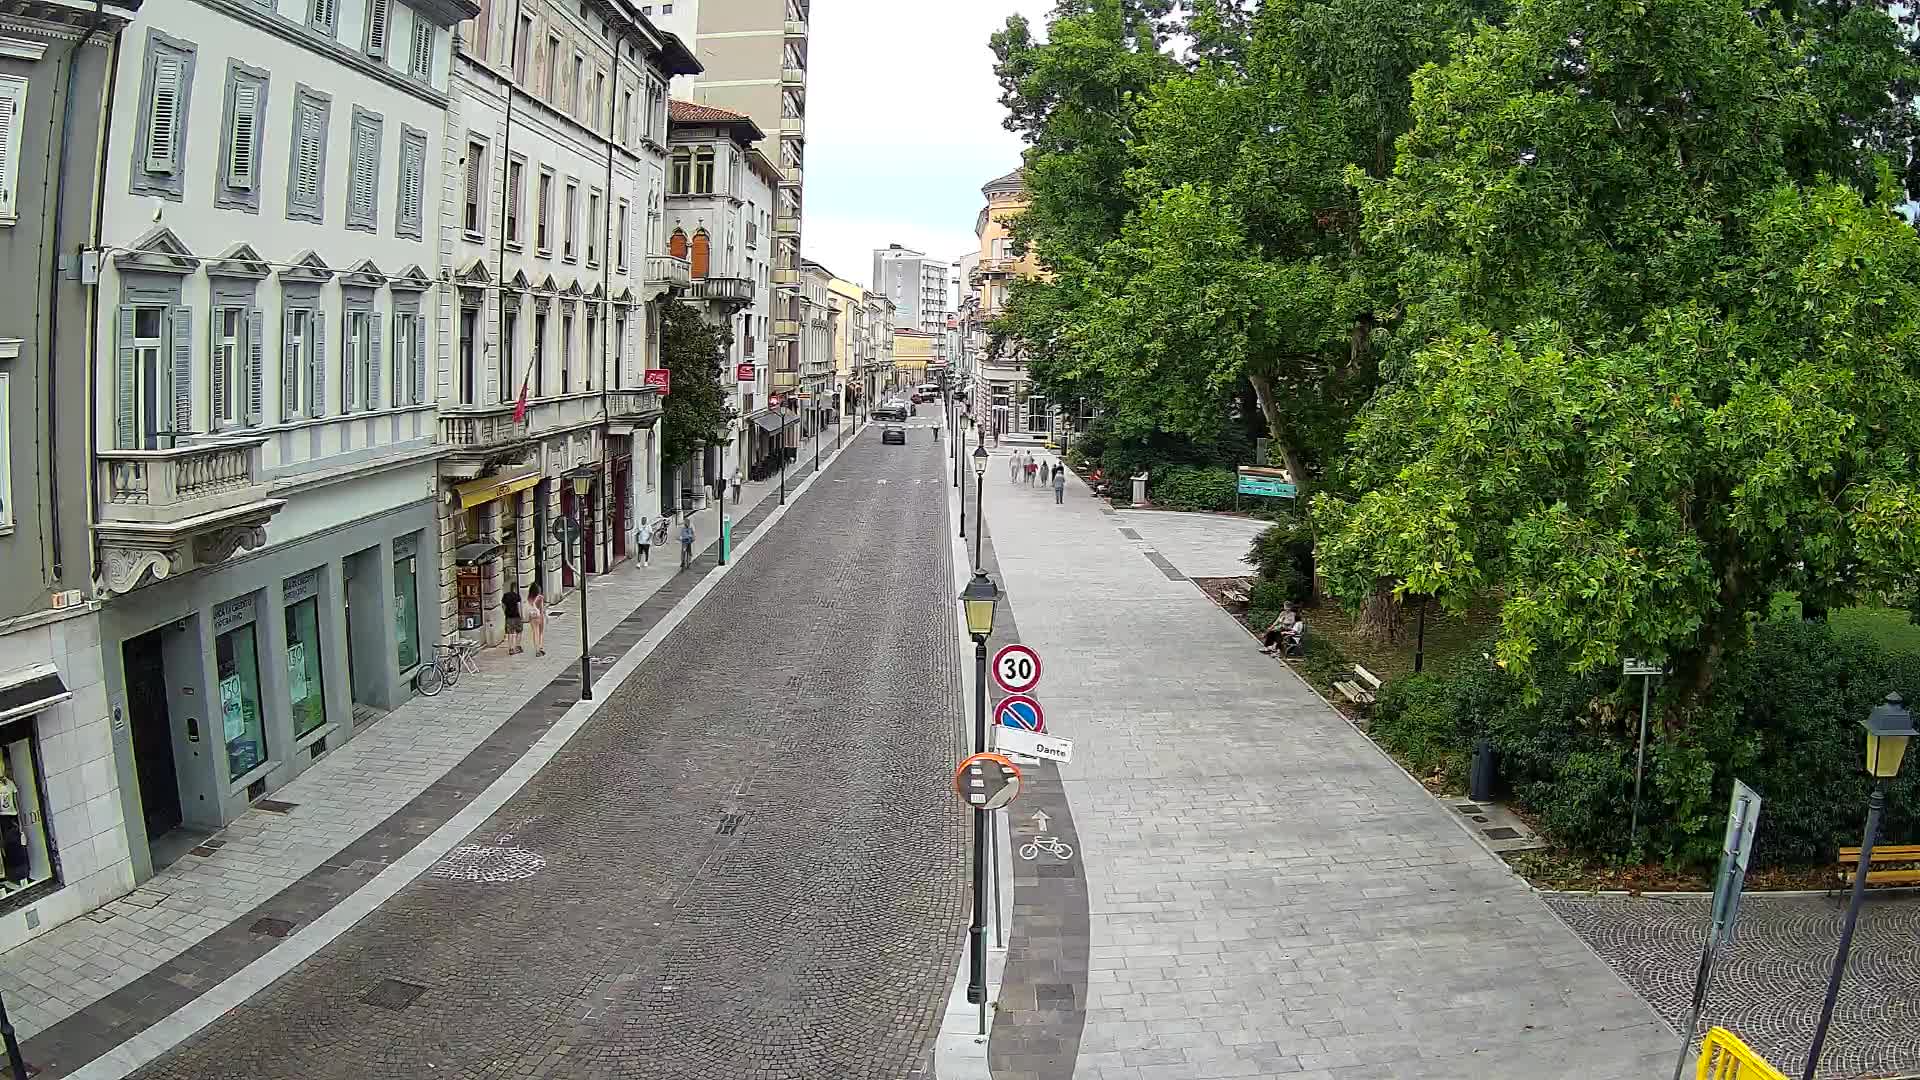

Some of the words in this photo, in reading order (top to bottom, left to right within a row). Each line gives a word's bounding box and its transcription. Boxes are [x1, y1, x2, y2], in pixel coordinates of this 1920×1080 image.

[1004, 658, 1031, 680] 30
[221, 678, 240, 701] 130
[1036, 743, 1066, 757] Dante
